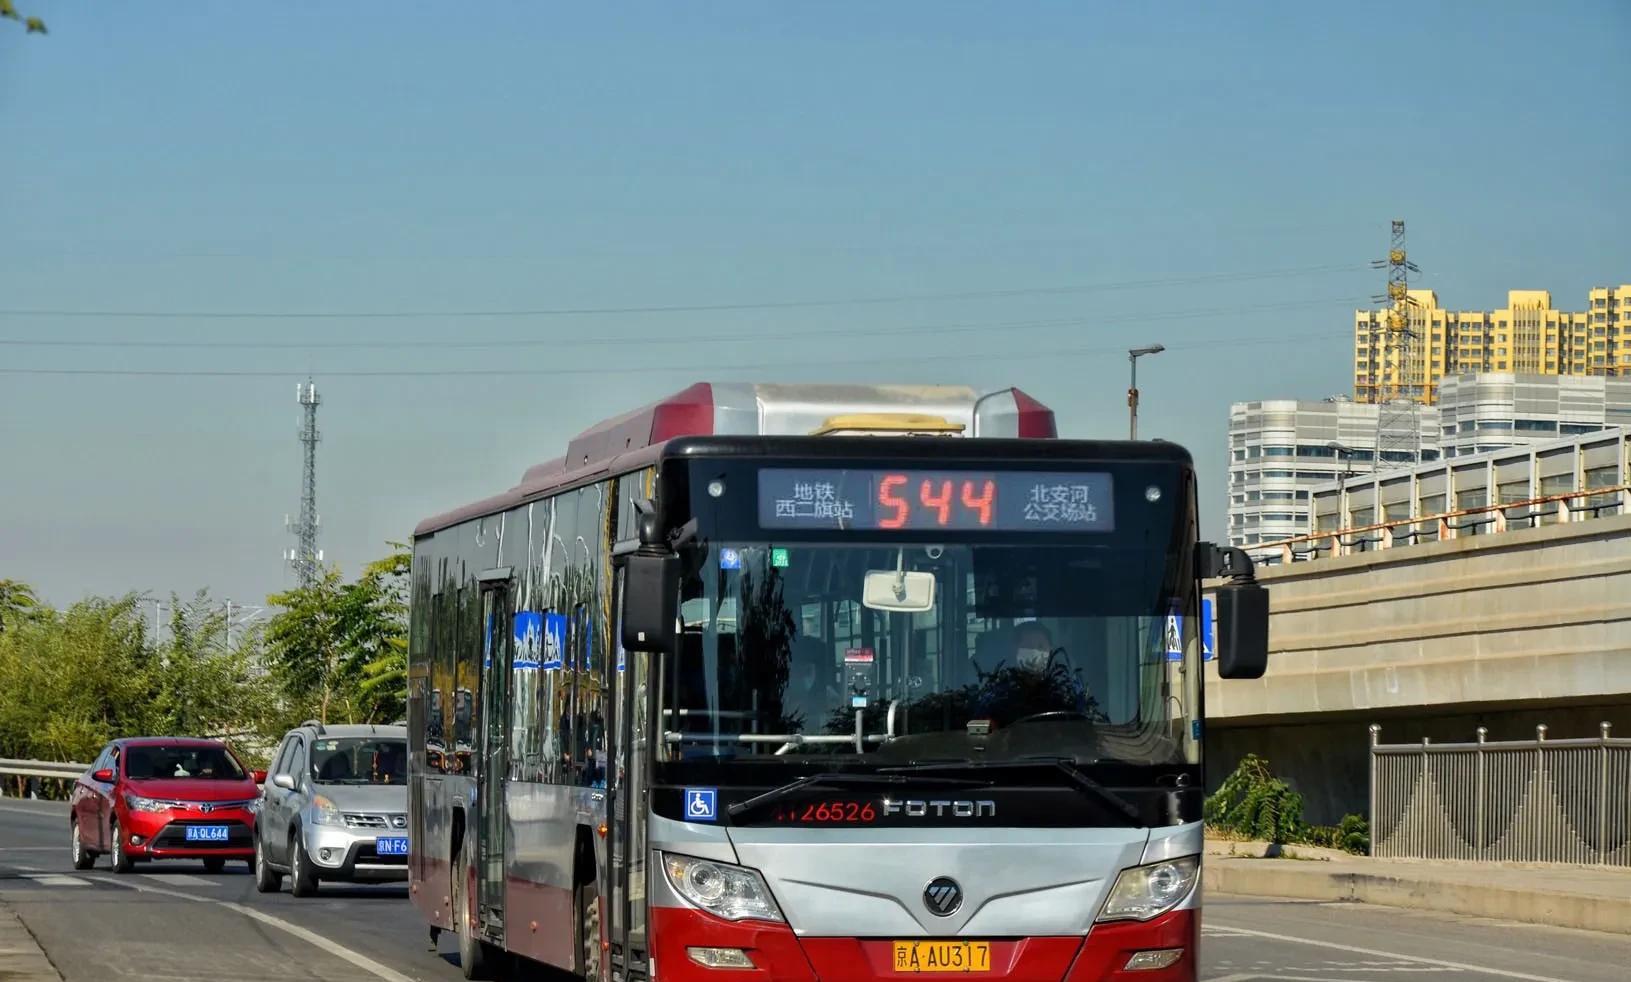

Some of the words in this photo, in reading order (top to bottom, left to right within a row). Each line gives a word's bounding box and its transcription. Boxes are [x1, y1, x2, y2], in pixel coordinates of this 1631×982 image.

[794, 483, 834, 500] 地铁
[1030, 484, 1088, 503] 北安河
[776, 500, 855, 518] 西二旗站
[878, 474, 994, 528] 544
[1024, 503, 1096, 521] 公交场站
[778, 802, 875, 821] 26526
[883, 799, 995, 816] FOTON
